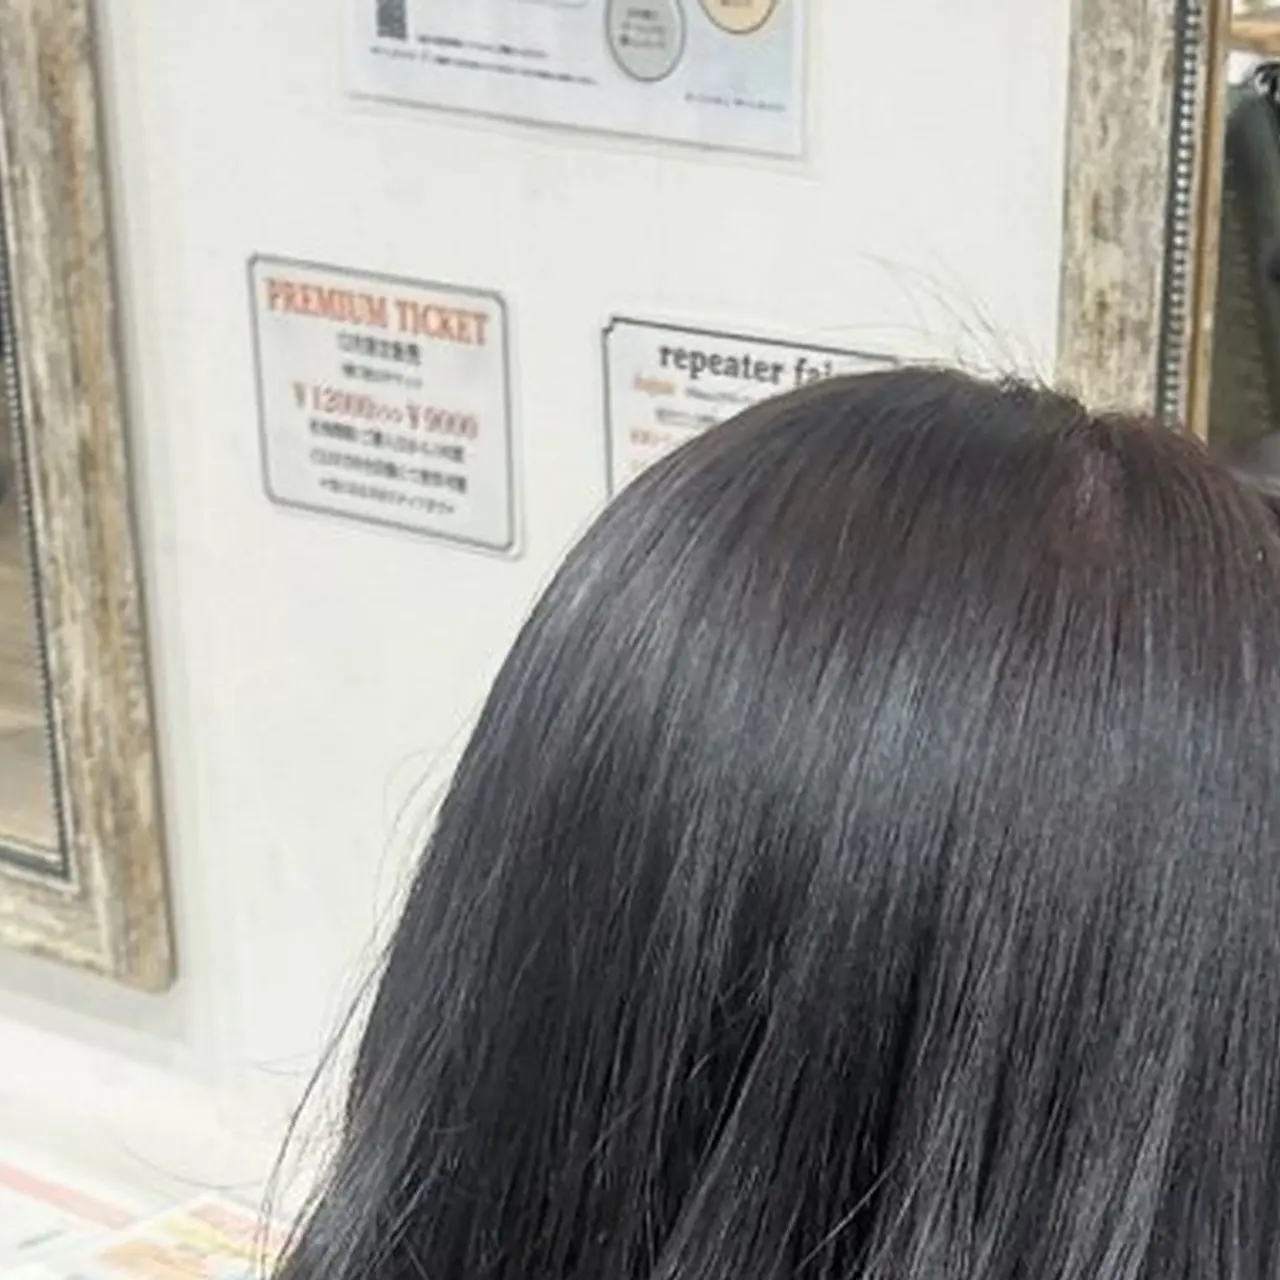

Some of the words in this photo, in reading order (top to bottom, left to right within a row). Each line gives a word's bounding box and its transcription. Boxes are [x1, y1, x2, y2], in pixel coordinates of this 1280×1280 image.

[263, 276, 389, 329] PREMIUM
[393, 299, 490, 346] TICKET
[658, 345, 785, 386] repeater
